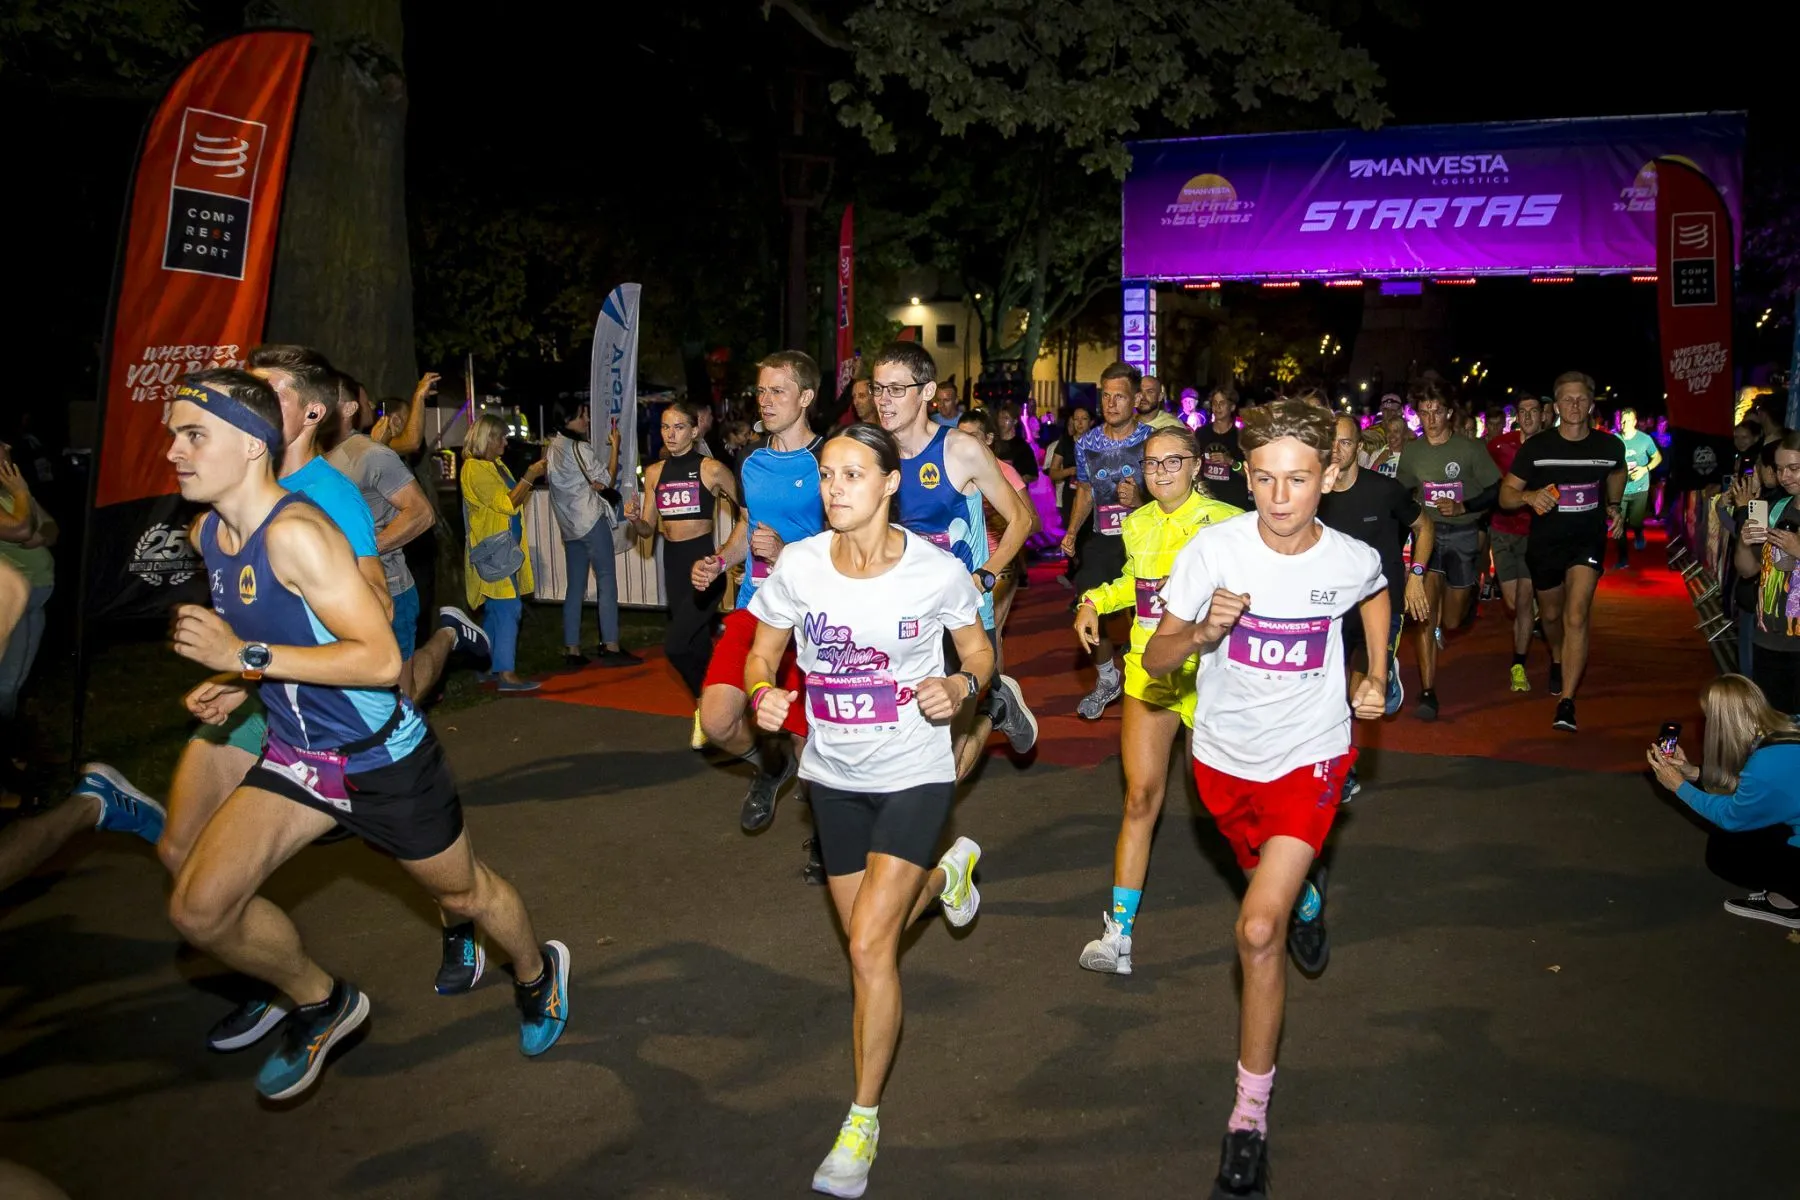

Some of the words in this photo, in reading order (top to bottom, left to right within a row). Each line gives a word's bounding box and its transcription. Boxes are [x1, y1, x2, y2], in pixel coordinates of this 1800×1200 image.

[1369, 154, 1509, 177] MANVESTA
[1433, 177, 1510, 185] LOGISTICS
[187, 207, 236, 224] COMP
[1300, 194, 1563, 232] STARTAS
[183, 242, 229, 259] PORT
[142, 344, 240, 362] WHEREVER
[125, 362, 181, 389] YOU
[662, 490, 691, 506] 346
[1575, 491, 1585, 504] 3
[1310, 589, 1338, 602] EA7
[804, 612, 852, 646] Nes
[901, 629, 916, 638] RUN
[1265, 621, 1311, 630] MANVESTA
[1247, 635, 1308, 667] 104
[829, 676, 872, 685] MANVESTA
[824, 692, 877, 720] 152
